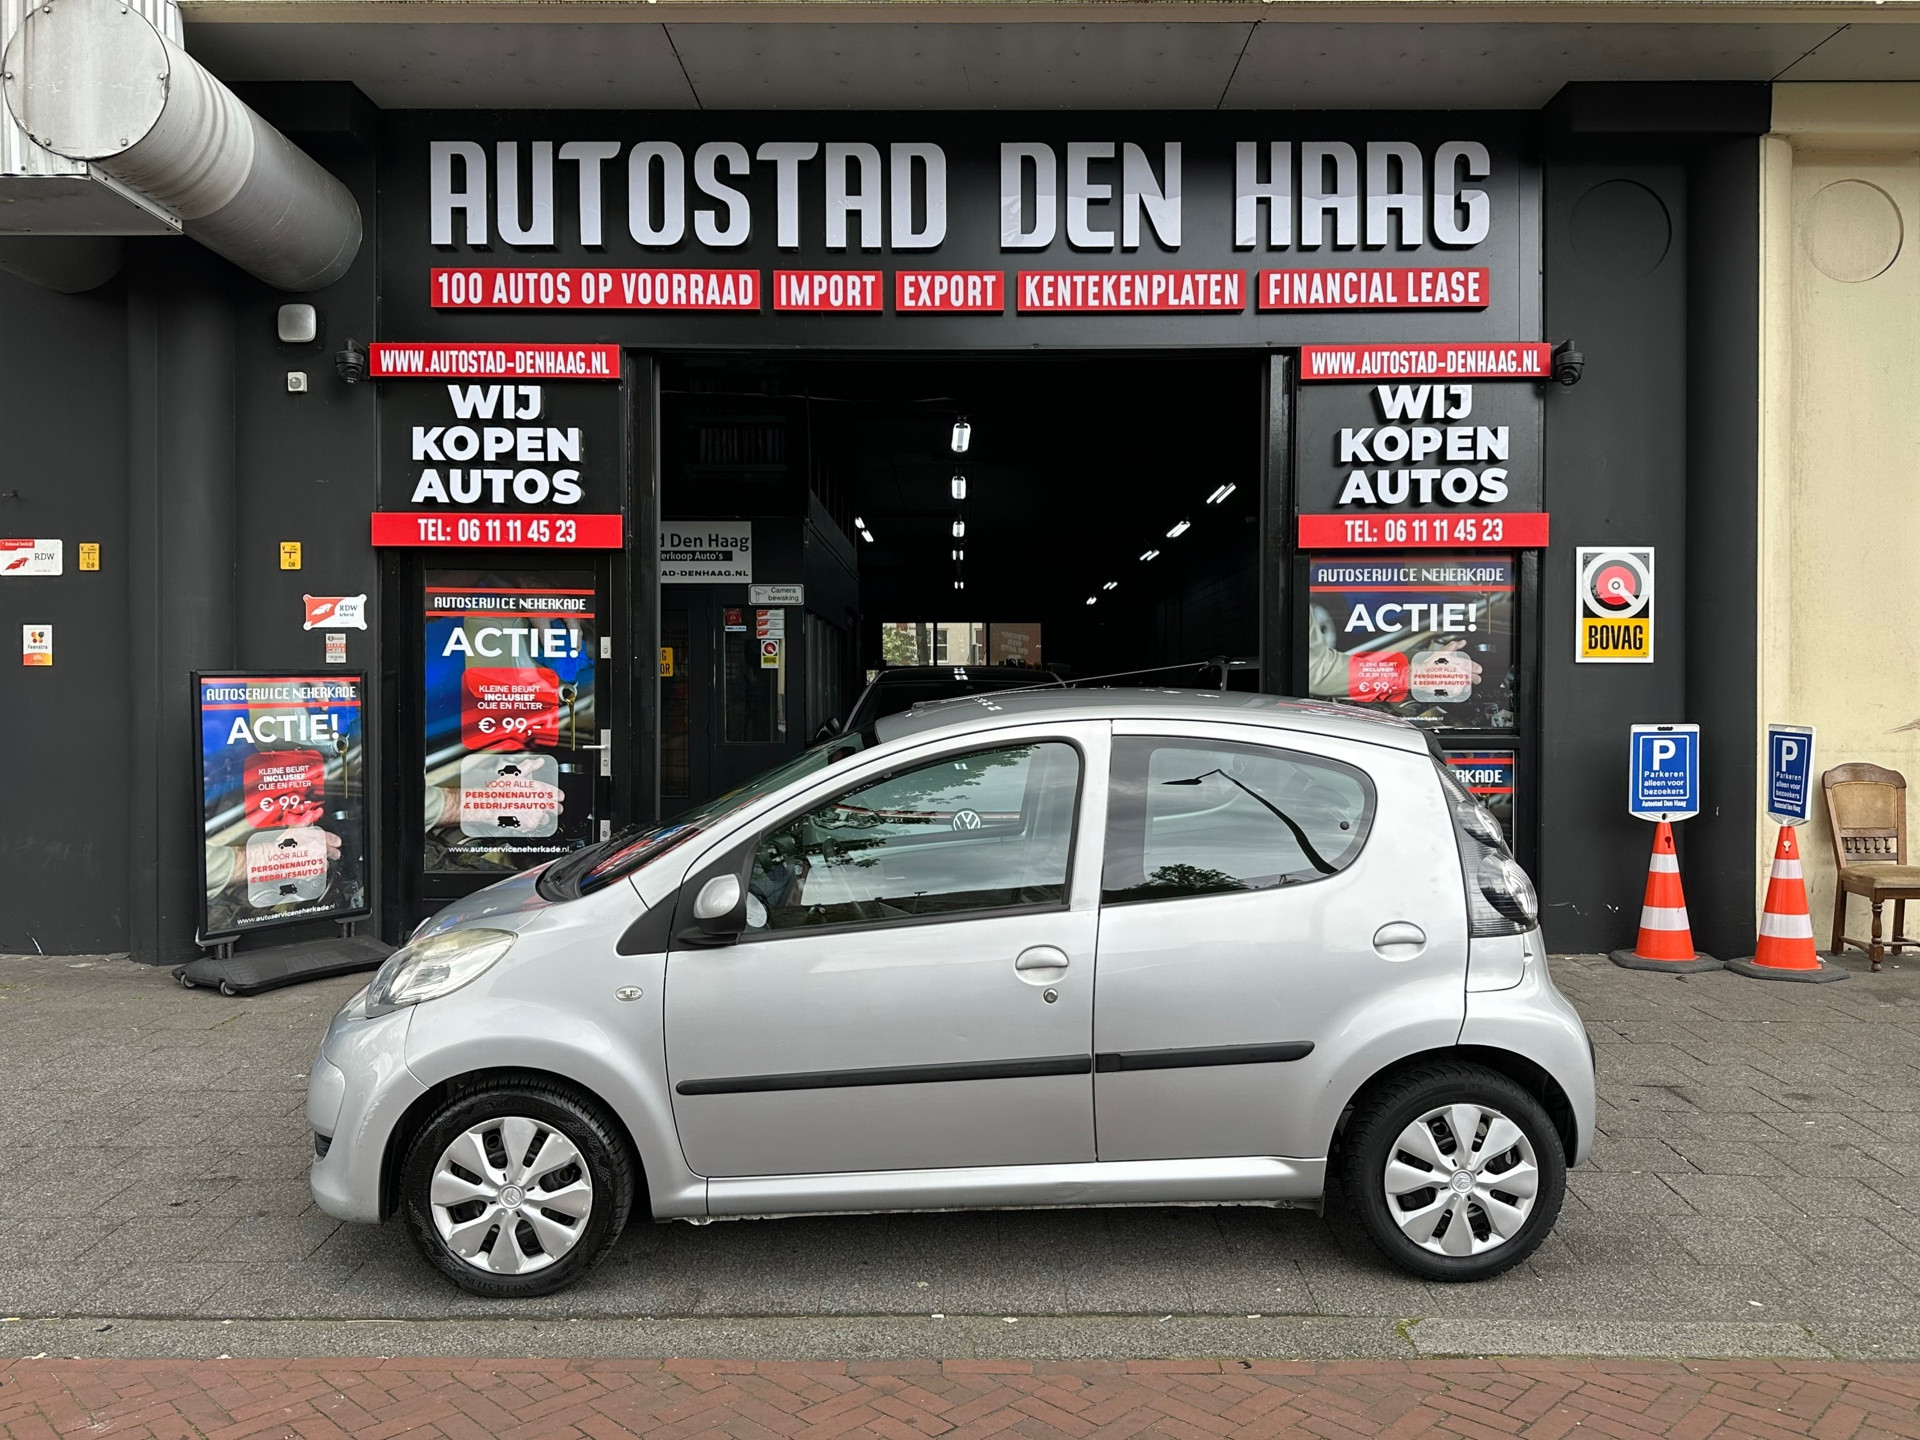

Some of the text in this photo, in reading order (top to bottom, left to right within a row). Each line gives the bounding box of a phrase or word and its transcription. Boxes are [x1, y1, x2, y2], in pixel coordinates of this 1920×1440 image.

[430, 140, 1490, 248] AUTOSTAD DEN HAAG
[438, 272, 753, 306] 100 AUTOS OP VOORRAAD
[780, 275, 876, 307] IMPORT
[904, 275, 997, 307] EXPORT
[1025, 273, 1239, 307] KENTEKENPLATEN
[1268, 270, 1481, 305] FINANCIAL LEASE
[380, 350, 610, 374] WWW.AUTOSTAD-DENHAAG.NL
[1311, 350, 1541, 375] WWW.AUTOSTAD-DENHAAG.NL
[447, 385, 542, 420] WIJ
[1377, 384, 1473, 420] WIJ
[412, 425, 581, 462] KOPEN
[1340, 425, 1509, 462] KOPEN
[411, 468, 582, 505] AUTOS
[1338, 467, 1509, 505] AUTOS
[418, 518, 577, 543] TEL: 06 11 11 45 23
[1345, 518, 1503, 543] TEL: 06 11 11 45 23
[670, 533, 703, 548] Den
[708, 533, 750, 552] Haag
[660, 551, 724, 562] erkoop Auto's
[1318, 567, 1504, 582] AUTOSERVICE NEHERKADE
[434, 596, 586, 611] AUTOSERVICE NEHERKADE
[768, 594, 799, 602] bewaking
[1344, 603, 1478, 633] ACTIE!
[442, 627, 579, 659] ACTIE!
[1588, 624, 1644, 651] BOVAG
[206, 686, 357, 702] AUTOSERVICE NEHERKADE
[478, 684, 540, 693] KLEINE BEURT
[1359, 682, 1398, 693] € 99,-
[477, 702, 542, 710] OLIE EN FILTER
[226, 714, 340, 745] ACTIE!
[478, 717, 542, 736] € 99,-
[1653, 740, 1676, 770] P
[1782, 740, 1798, 772] P
[258, 764, 310, 776] KLEINE BEURT
[264, 773, 306, 782] INCLUSIEF
[1450, 769, 1503, 783] RKADE
[1776, 772, 1801, 780] Parkeren
[258, 780, 312, 791] OLIE EN FILTER
[513, 780, 534, 788] ALLE
[260, 796, 312, 812] € 99,-
[465, 791, 553, 799] PERSONENAUTO'S
[1776, 790, 1800, 799] bezoekers
[473, 802, 555, 810] BEDRIJFSAUTO'S
[251, 858, 324, 873] PERSONENAUTO'S
[268, 850, 309, 862] VOOR ALLE
[258, 867, 325, 883] BEDRIJFSAUTO'S
